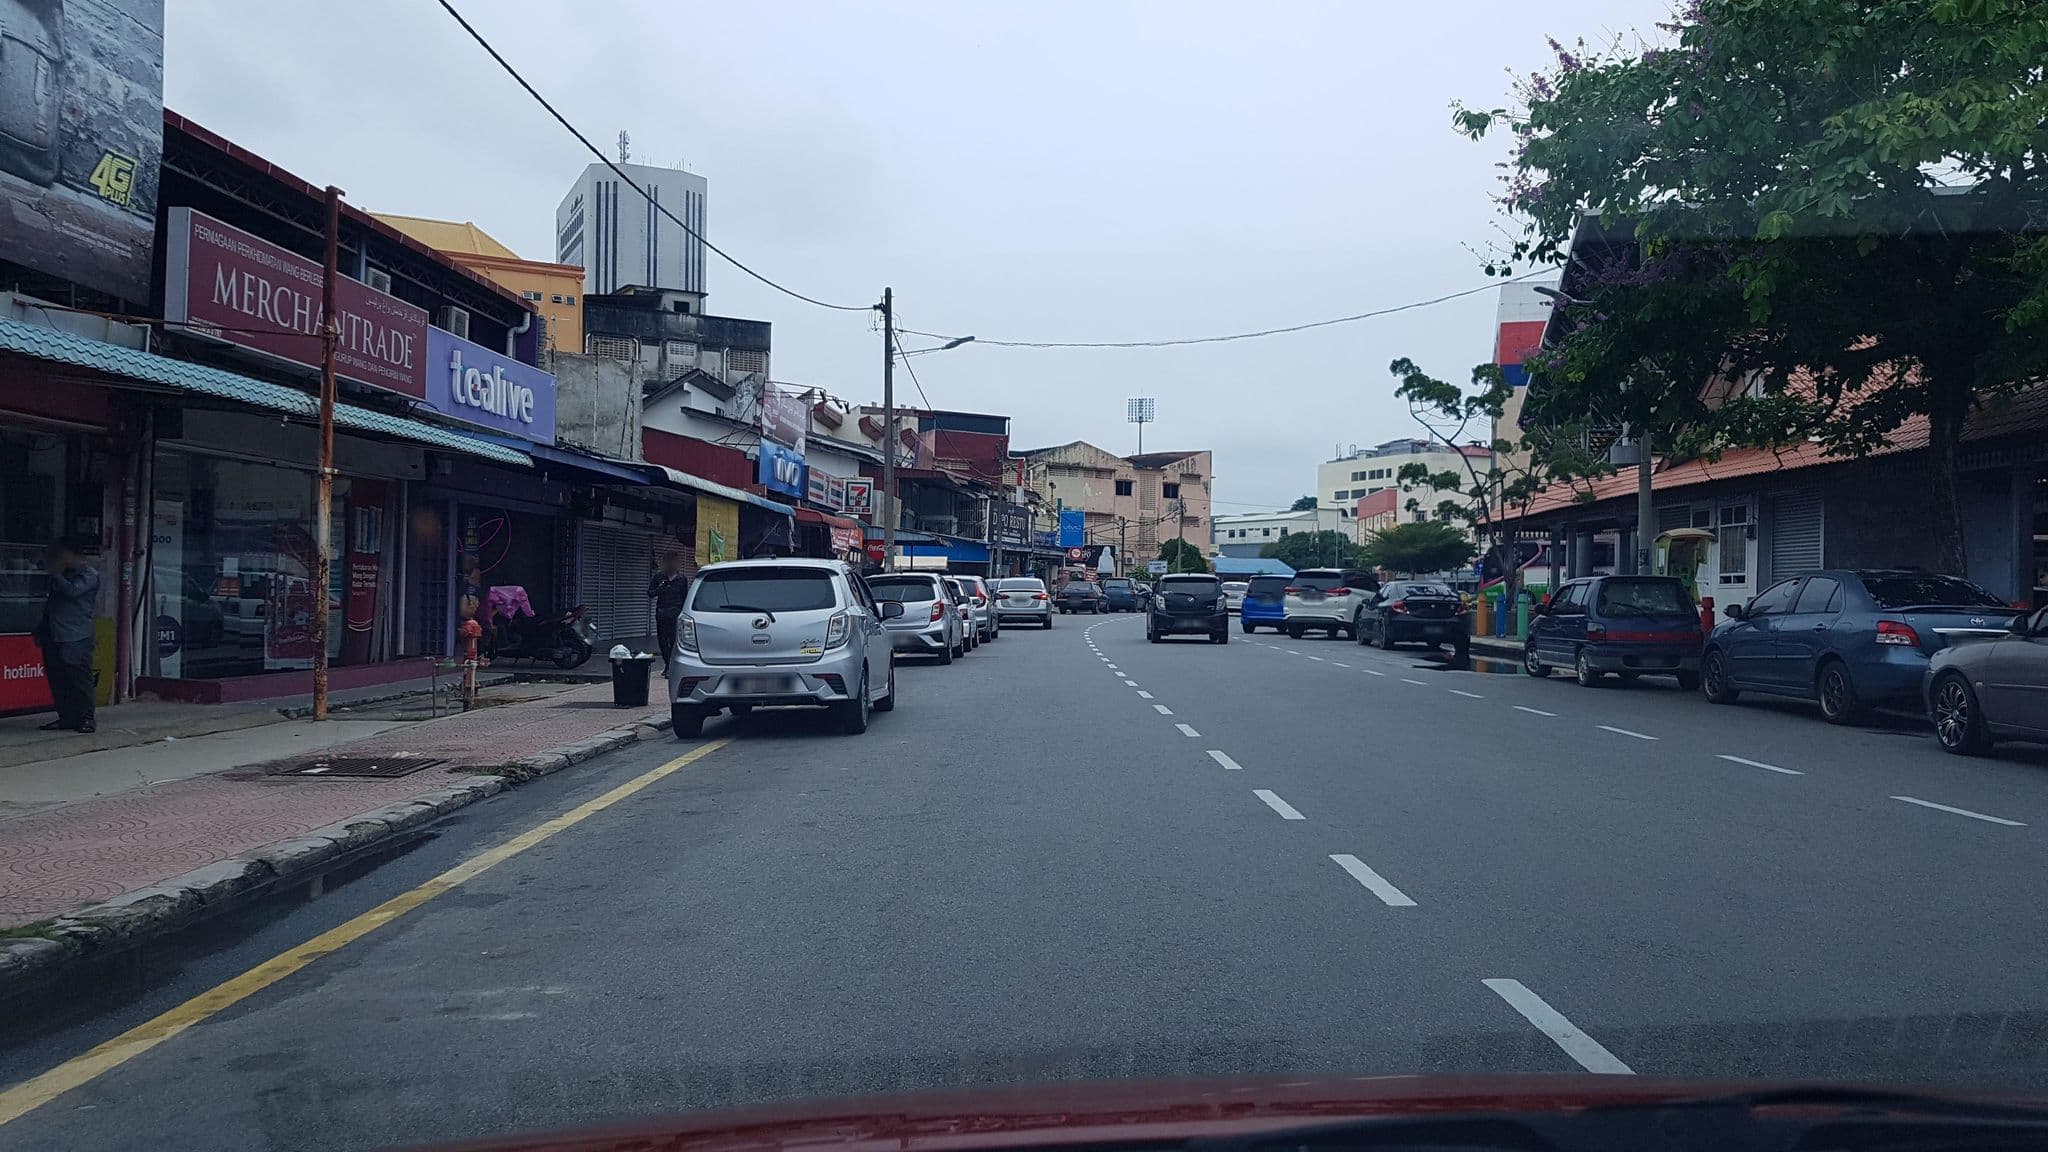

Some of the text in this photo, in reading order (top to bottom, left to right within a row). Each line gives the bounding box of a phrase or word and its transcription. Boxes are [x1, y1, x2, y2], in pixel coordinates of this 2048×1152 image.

[90, 150, 135, 196] 4G
[105, 186, 128, 205] PLUS
[282, 260, 300, 279] WANG
[450, 350, 534, 423] tealive
[773, 449, 800, 487] vivo
[992, 512, 1009, 527] DPO
[4, 663, 45, 680] hotlink
